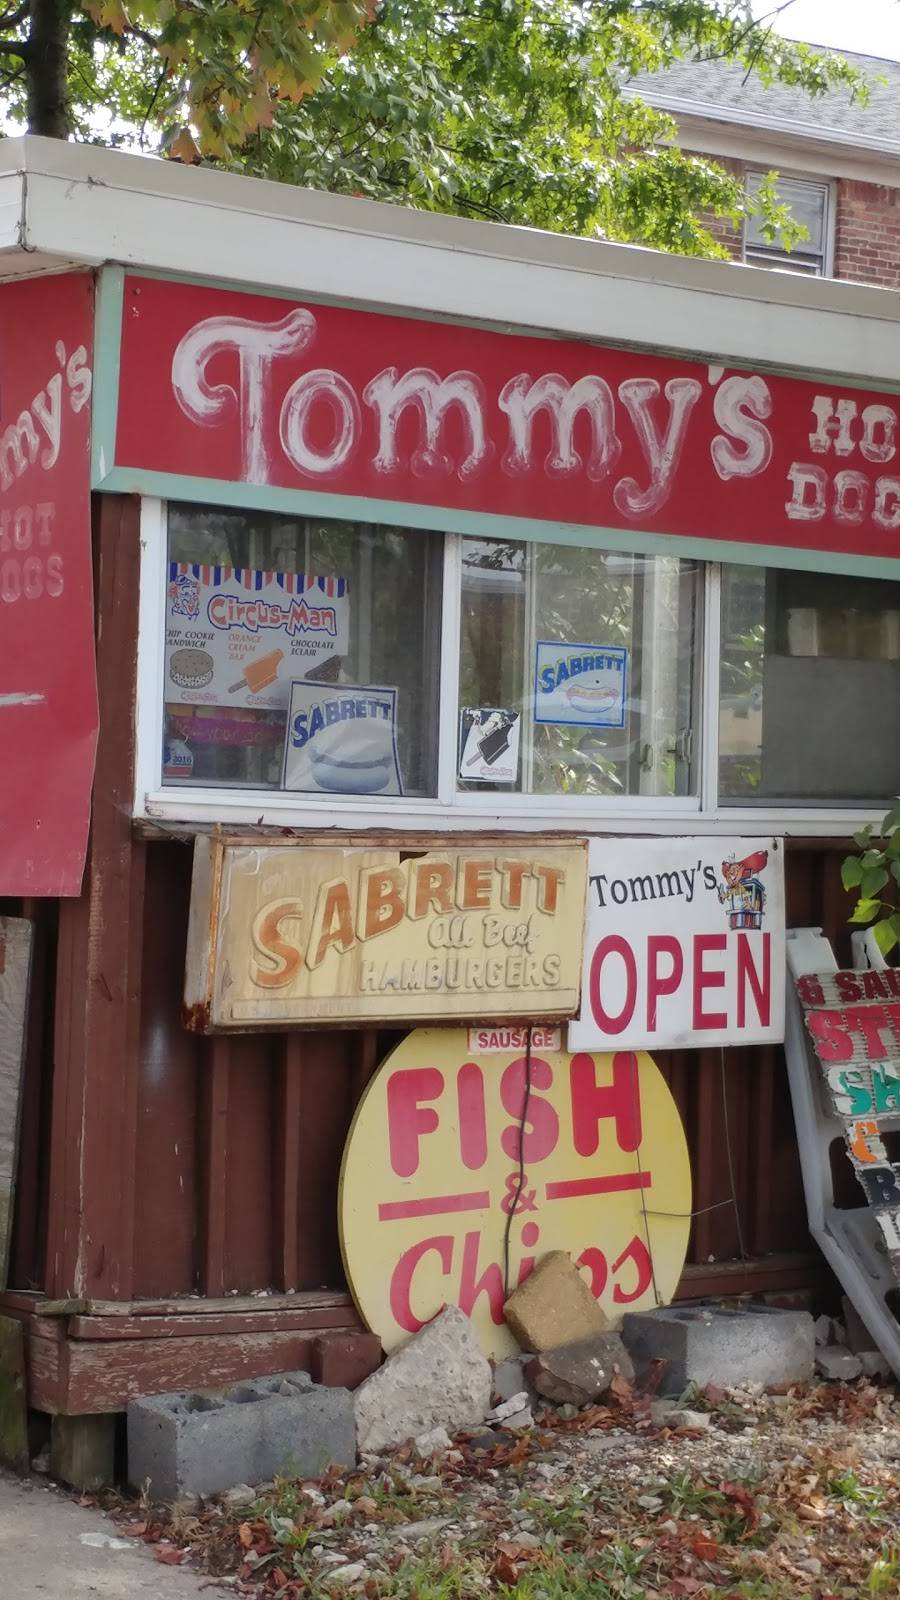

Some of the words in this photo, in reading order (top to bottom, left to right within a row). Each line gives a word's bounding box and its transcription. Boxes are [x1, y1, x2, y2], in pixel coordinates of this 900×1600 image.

[172, 308, 773, 519] Tommy's
[291, 640, 335, 649] CHOCOLATE
[291, 648, 316, 656] ECLAIR
[541, 653, 624, 694] SABRETT
[292, 696, 392, 748] SABRETT
[589, 860, 717, 907] Tommy's
[250, 856, 566, 989] SABRETT
[360, 953, 562, 992] HAMBURGERS
[590, 933, 771, 1035] OPEN
[478, 1031, 554, 1048] SAUSAGE
[387, 1052, 643, 1178] FISH
[501, 1172, 538, 1216] &
